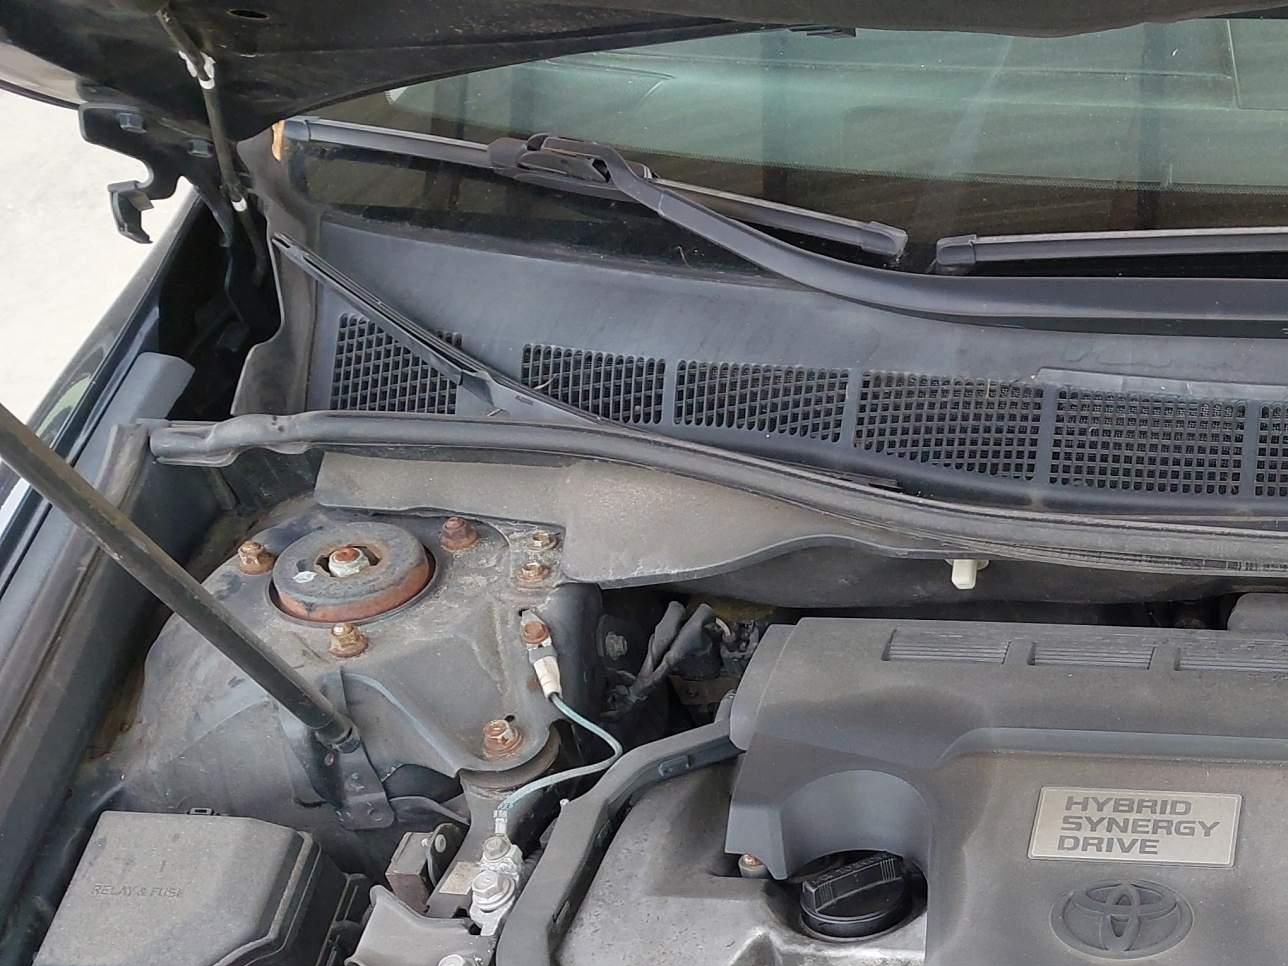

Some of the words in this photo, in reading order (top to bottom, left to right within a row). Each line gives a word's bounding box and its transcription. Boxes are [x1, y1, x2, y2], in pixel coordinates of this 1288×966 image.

[1065, 796, 1192, 815] HYBRID
[1061, 816, 1220, 837] SYNERGY
[1057, 835, 1160, 855] DRIVE
